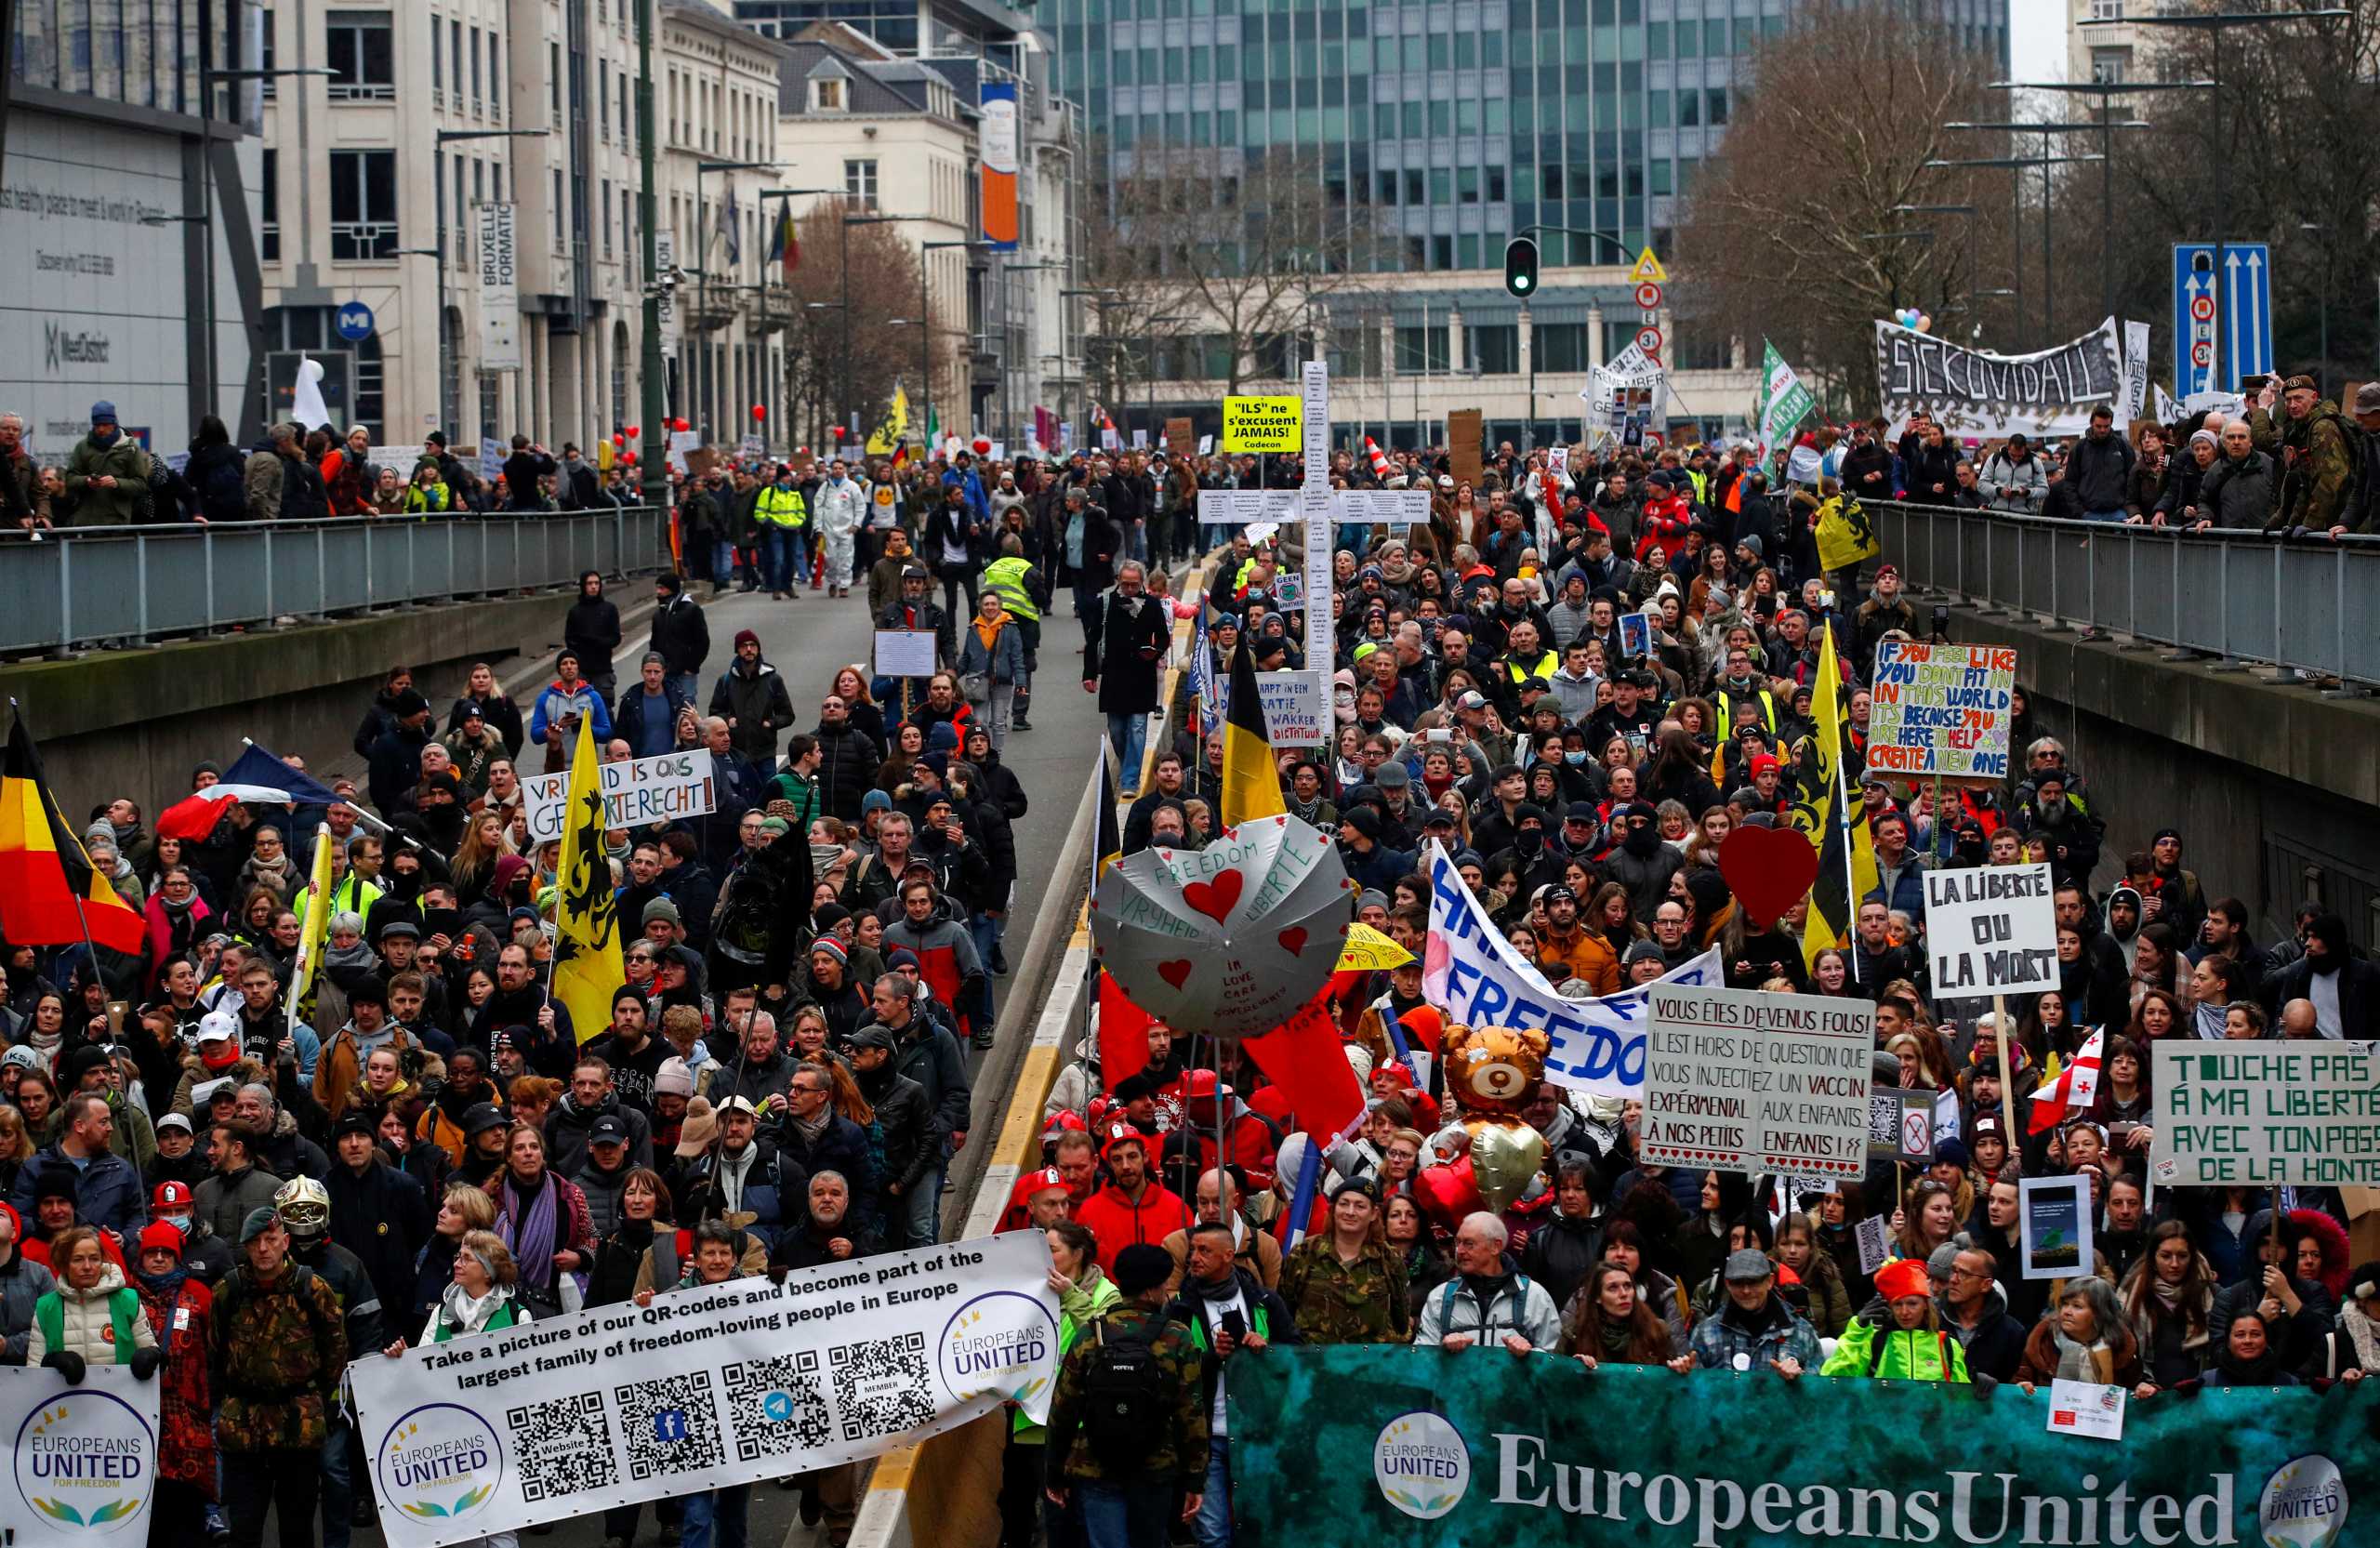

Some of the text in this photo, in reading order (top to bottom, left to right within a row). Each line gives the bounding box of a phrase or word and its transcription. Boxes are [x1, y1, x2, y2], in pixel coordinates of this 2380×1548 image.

[1228, 415, 1297, 426] s'excusent
[1235, 402, 1288, 414] "ILS" ne
[1233, 427, 1289, 438] JAMAIS!
[1276, 574, 1300, 584] GEEN
[1878, 642, 1898, 663] IF
[1897, 644, 1930, 663] YOU
[1933, 644, 1968, 663] FEEL
[1875, 662, 1915, 683] YOU
[1964, 667, 1988, 687] FIT
[1947, 686, 2010, 710] WORLD
[1271, 714, 1316, 726] WAKKER
[1903, 705, 1963, 727] BECAUSE
[1962, 708, 1994, 730] YOU
[1869, 724, 1983, 750] ARE HERE TO HELP
[631, 756, 694, 783] IS ONS
[1868, 745, 2007, 775] CREATE A NEW ONE
[1154, 841, 1259, 886] FREEDOM
[1929, 876, 1961, 907] LA
[1972, 913, 2012, 945] OU
[1223, 972, 1254, 986] LOVE
[1938, 948, 2056, 988] LA MORT
[1223, 984, 1256, 999] CARE
[1447, 956, 1647, 1087] FREEDO
[1656, 998, 1698, 1021] VOUS
[1703, 999, 1738, 1024] ÊTES
[1744, 1005, 1817, 1031] DEVENUS
[1823, 1012, 1871, 1035] FOUS!
[1666, 1033, 1691, 1055] EST
[1695, 1037, 1735, 1059] HORS
[1742, 1040, 1763, 1063] DE
[1841, 1048, 1867, 1069] QUE
[1652, 1062, 1690, 1085] VOUS
[1779, 1074, 1802, 1094] UN
[2311, 1055, 2369, 1081] PAS
[1762, 1105, 1793, 1124] AUX
[2201, 1087, 2249, 1116] MA
[1665, 1124, 1696, 1144] NOS
[1764, 1131, 1832, 1156] ENFANTS
[2172, 1125, 2250, 1153] AVEC
[2263, 1126, 2321, 1153] TON
[2199, 1158, 2236, 1182] DE
[2248, 1158, 2286, 1182] LA
[422, 1250, 984, 1371] Take a picture of our QR-codes and become part of the
[456, 1280, 959, 1390] largest family of freedom-loving people in Europe
[952, 1325, 1045, 1356] EUROPEANS
[954, 1340, 1046, 1375] UNITED
[864, 1380, 899, 1394] MEMBER
[32, 1436, 141, 1454] EUROPEANS
[390, 1435, 485, 1468] EUROPEANS
[540, 1440, 586, 1456] Website
[1382, 1444, 1460, 1461] EUROPEANS
[33, 1453, 141, 1479] UNITED
[394, 1449, 488, 1488] UNITED
[1383, 1457, 1459, 1479] UNITED
[53, 1478, 121, 1488] FOR FREEDOM
[433, 1472, 472, 1488] FREEDOM
[2270, 1479, 2339, 1502] EUROPEANS
[2268, 1493, 2339, 1521] UNITED
